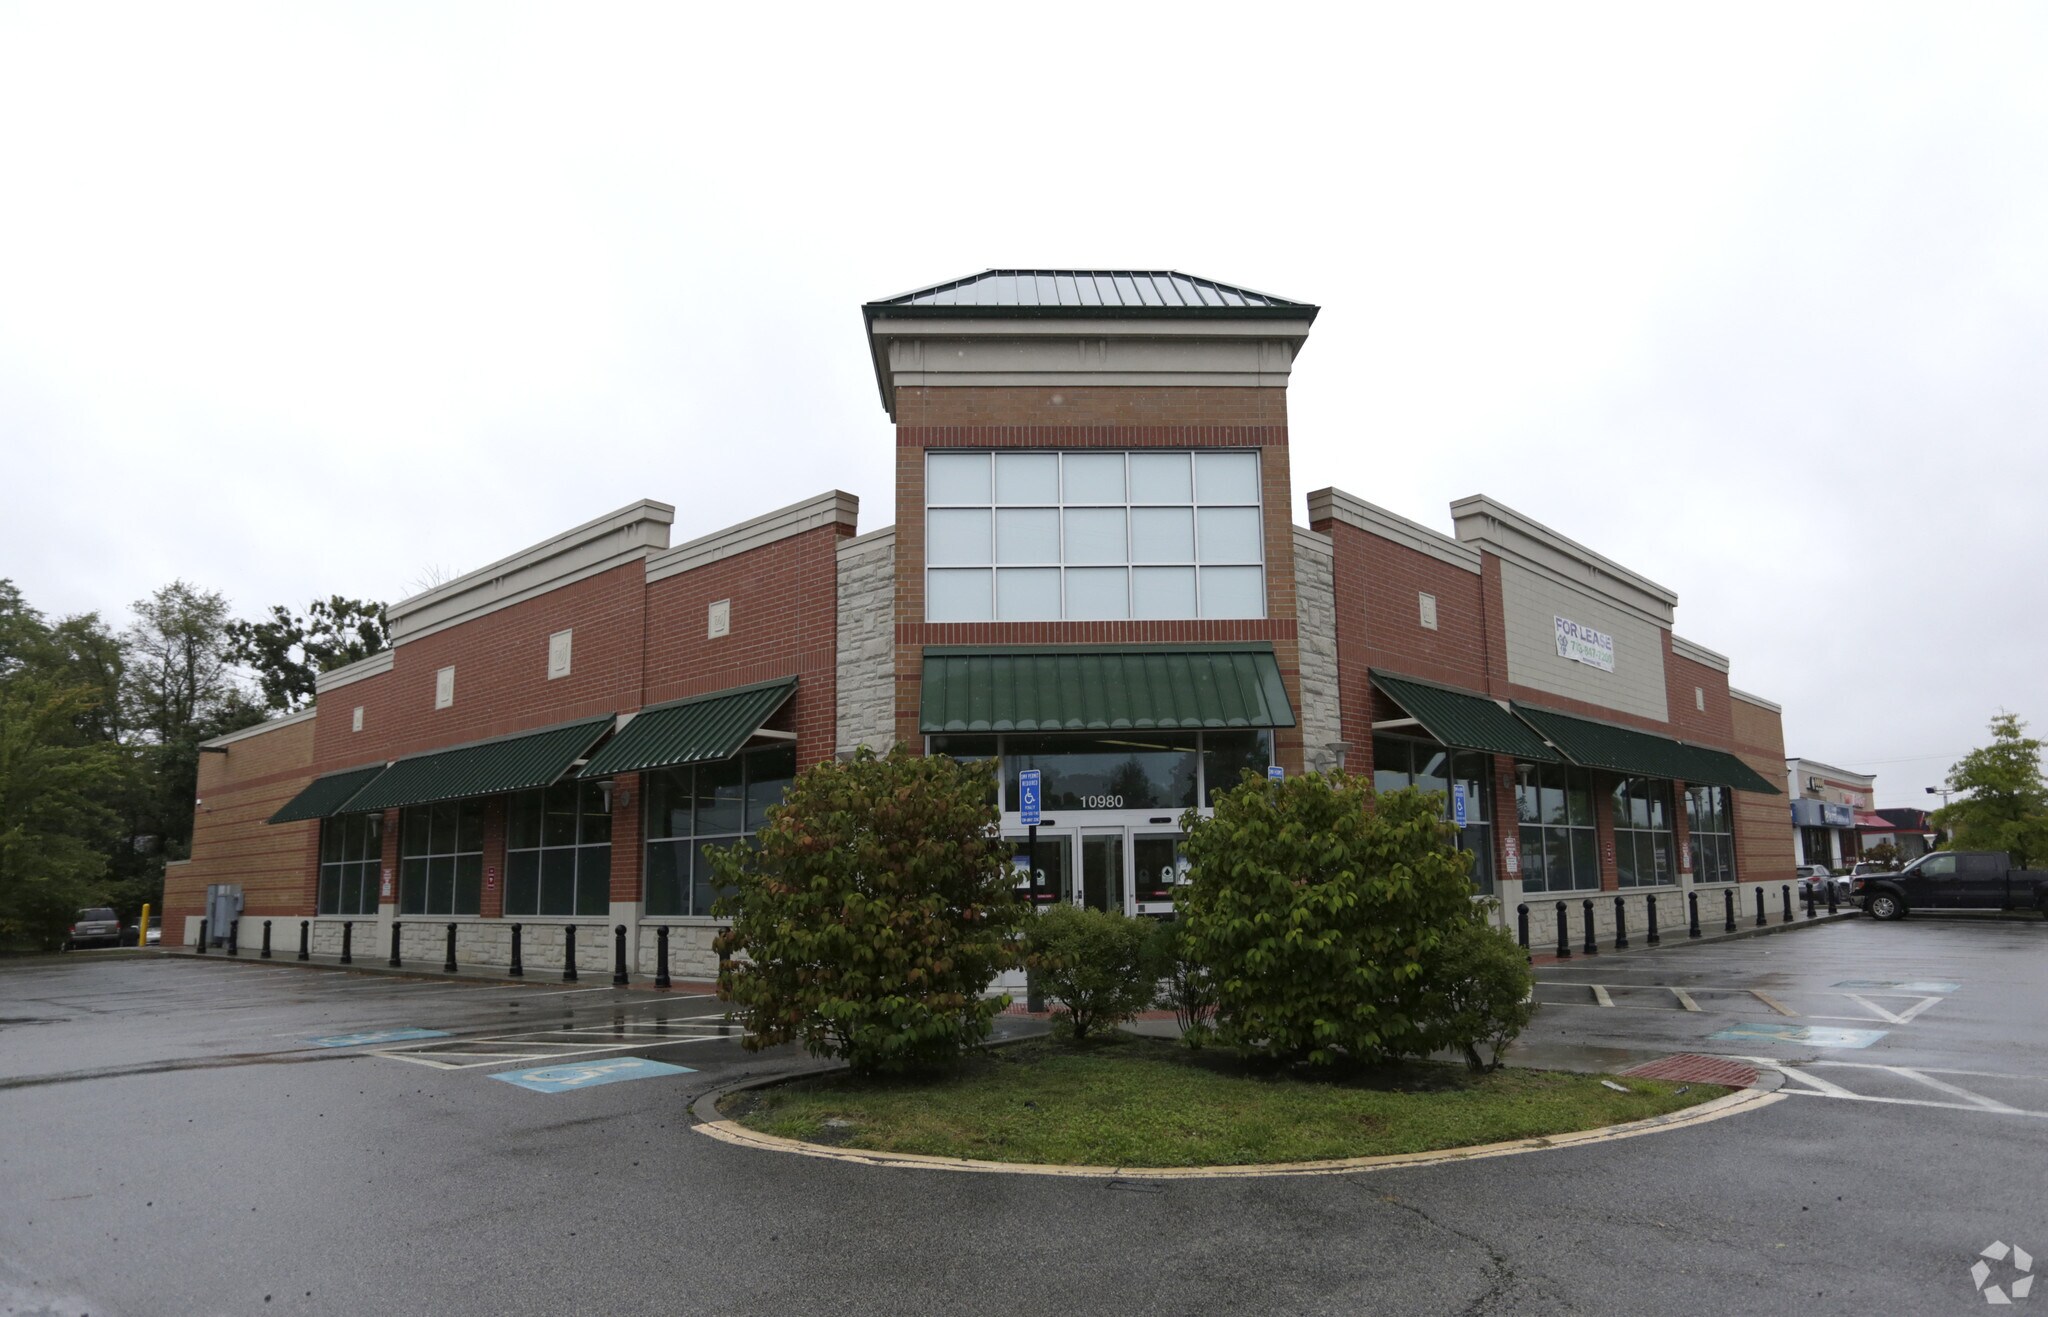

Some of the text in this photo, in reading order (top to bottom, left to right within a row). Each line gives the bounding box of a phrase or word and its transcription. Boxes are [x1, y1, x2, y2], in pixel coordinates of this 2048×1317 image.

[1555, 617, 1612, 651] FOR LEASE
[1080, 795, 1123, 808] 10980
